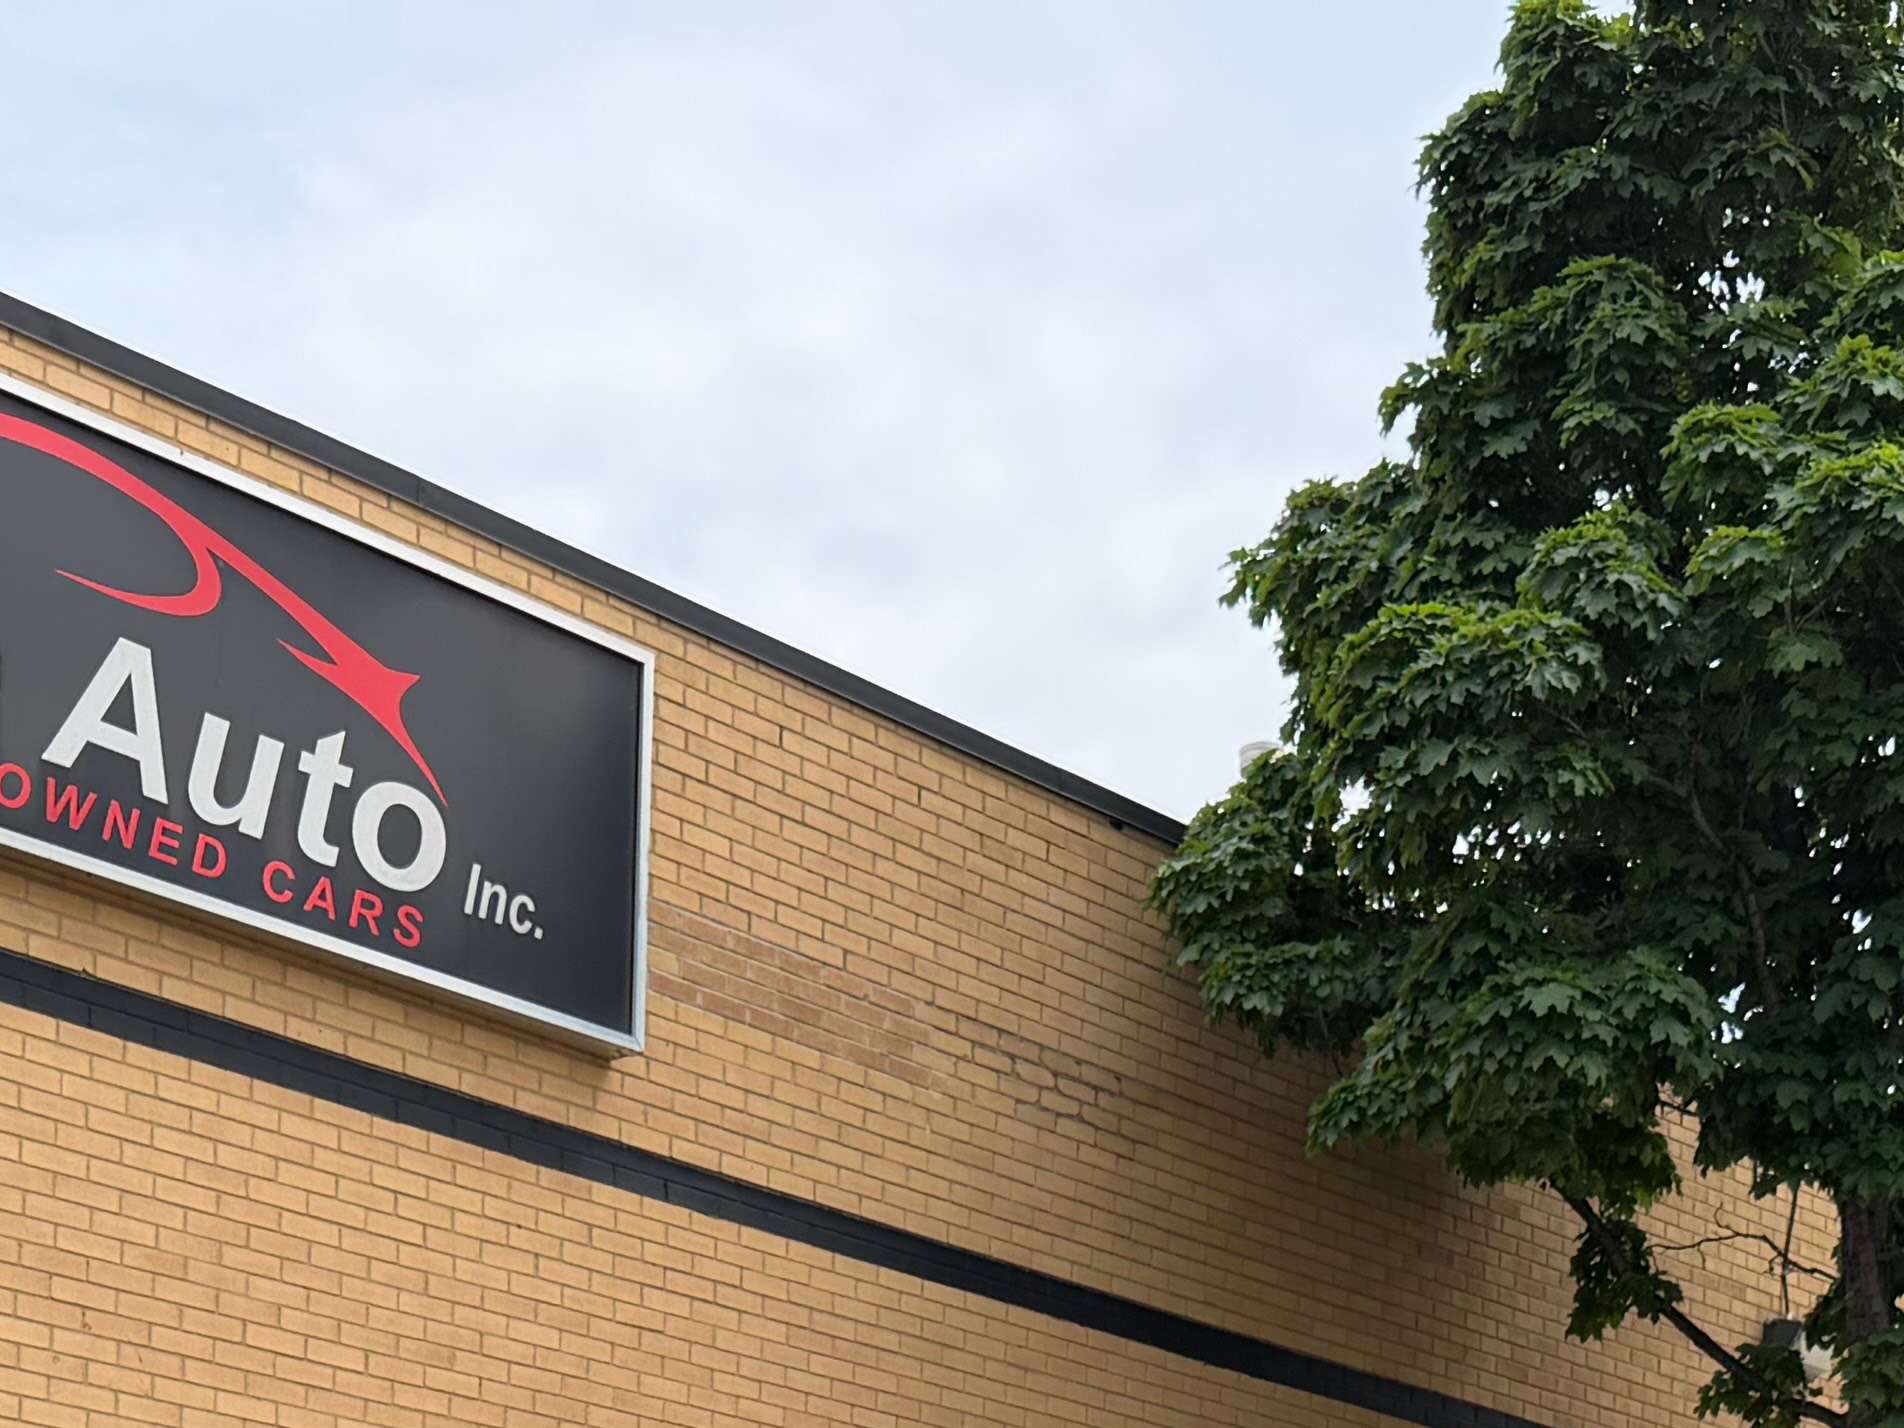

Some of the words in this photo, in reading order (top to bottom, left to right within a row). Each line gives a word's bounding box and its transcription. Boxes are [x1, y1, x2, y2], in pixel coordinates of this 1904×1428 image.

[41, 636, 447, 892] Auto
[261, 861, 425, 948] CARS
[462, 863, 544, 940] Inc.
